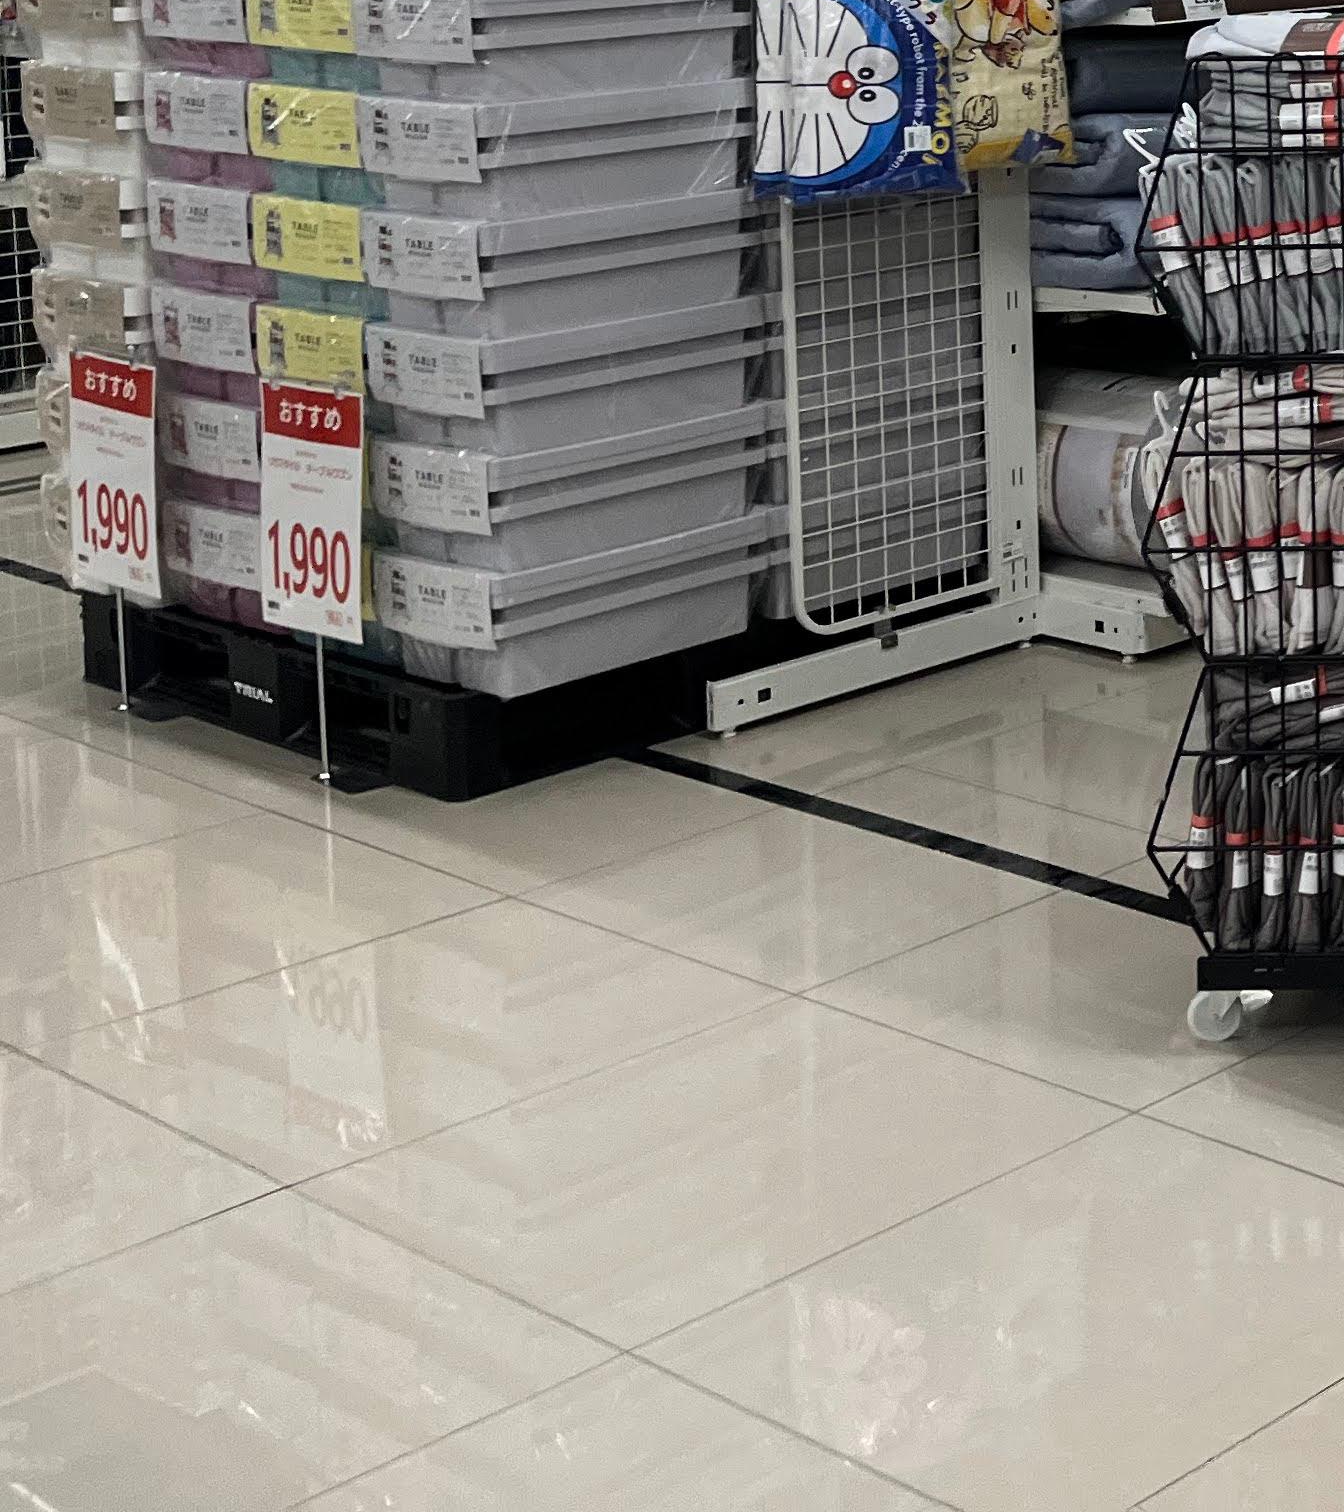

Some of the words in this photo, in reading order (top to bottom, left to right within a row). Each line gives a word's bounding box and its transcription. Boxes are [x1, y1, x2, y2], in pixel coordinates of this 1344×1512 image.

[909, 26, 926, 66] robot
[915, 67, 929, 97] from
[915, 98, 927, 119] the
[401, 121, 430, 135] TABLE
[405, 238, 433, 251] TABLE
[409, 354, 437, 367] TABLE
[84, 367, 138, 402] おすすめ
[279, 398, 342, 431] おすすめ
[415, 469, 443, 484] TABLE
[77, 479, 148, 561] 1,990
[268, 519, 351, 604] 1,990
[418, 584, 447, 600] TABLE
